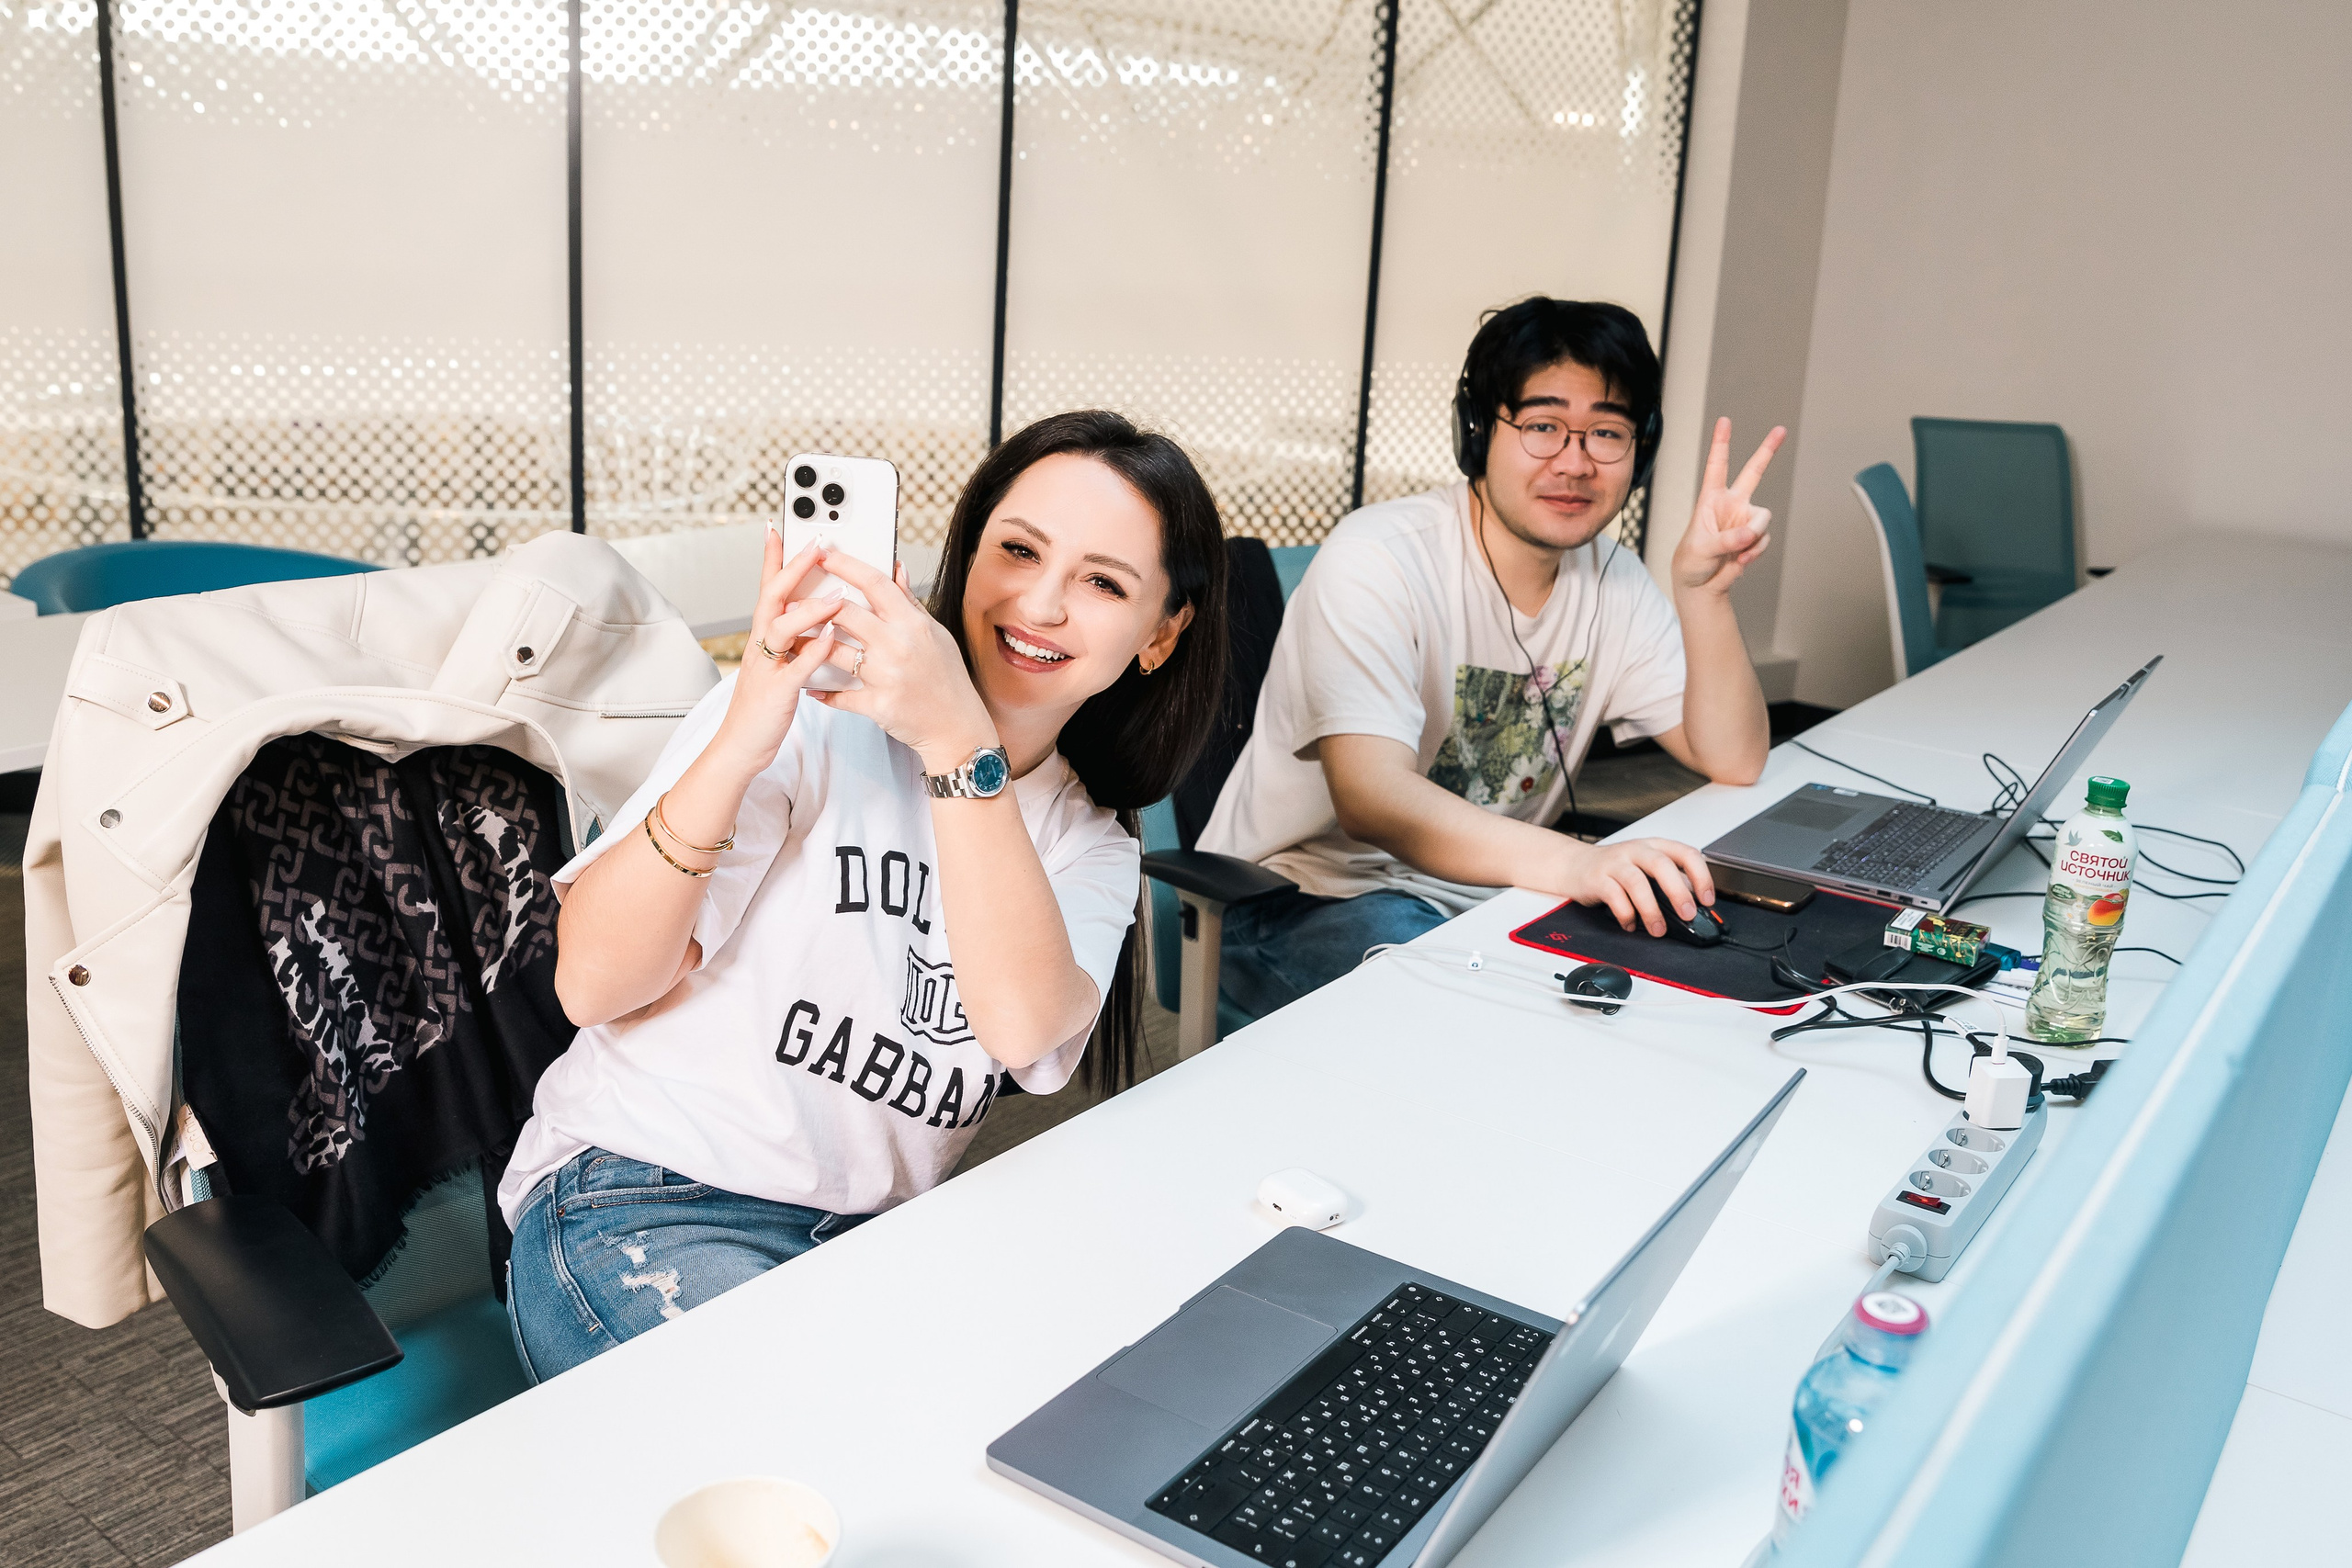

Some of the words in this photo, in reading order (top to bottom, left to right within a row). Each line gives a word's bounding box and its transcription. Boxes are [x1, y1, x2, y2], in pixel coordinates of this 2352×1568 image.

[2070, 850, 2129, 869] СВЯТОЙ
[2060, 860, 2131, 882] ИСТОЧНИК
[836, 846, 947, 935] DOL
[1304, 1427, 1314, 1435] M
[1262, 1449, 1273, 1457] Ю
[1356, 1445, 1368, 1454] Ш
[1302, 1452, 1314, 1461] Д
[1337, 1461, 1350, 1471] Щ
[1283, 1470, 1295, 1480] Ж
